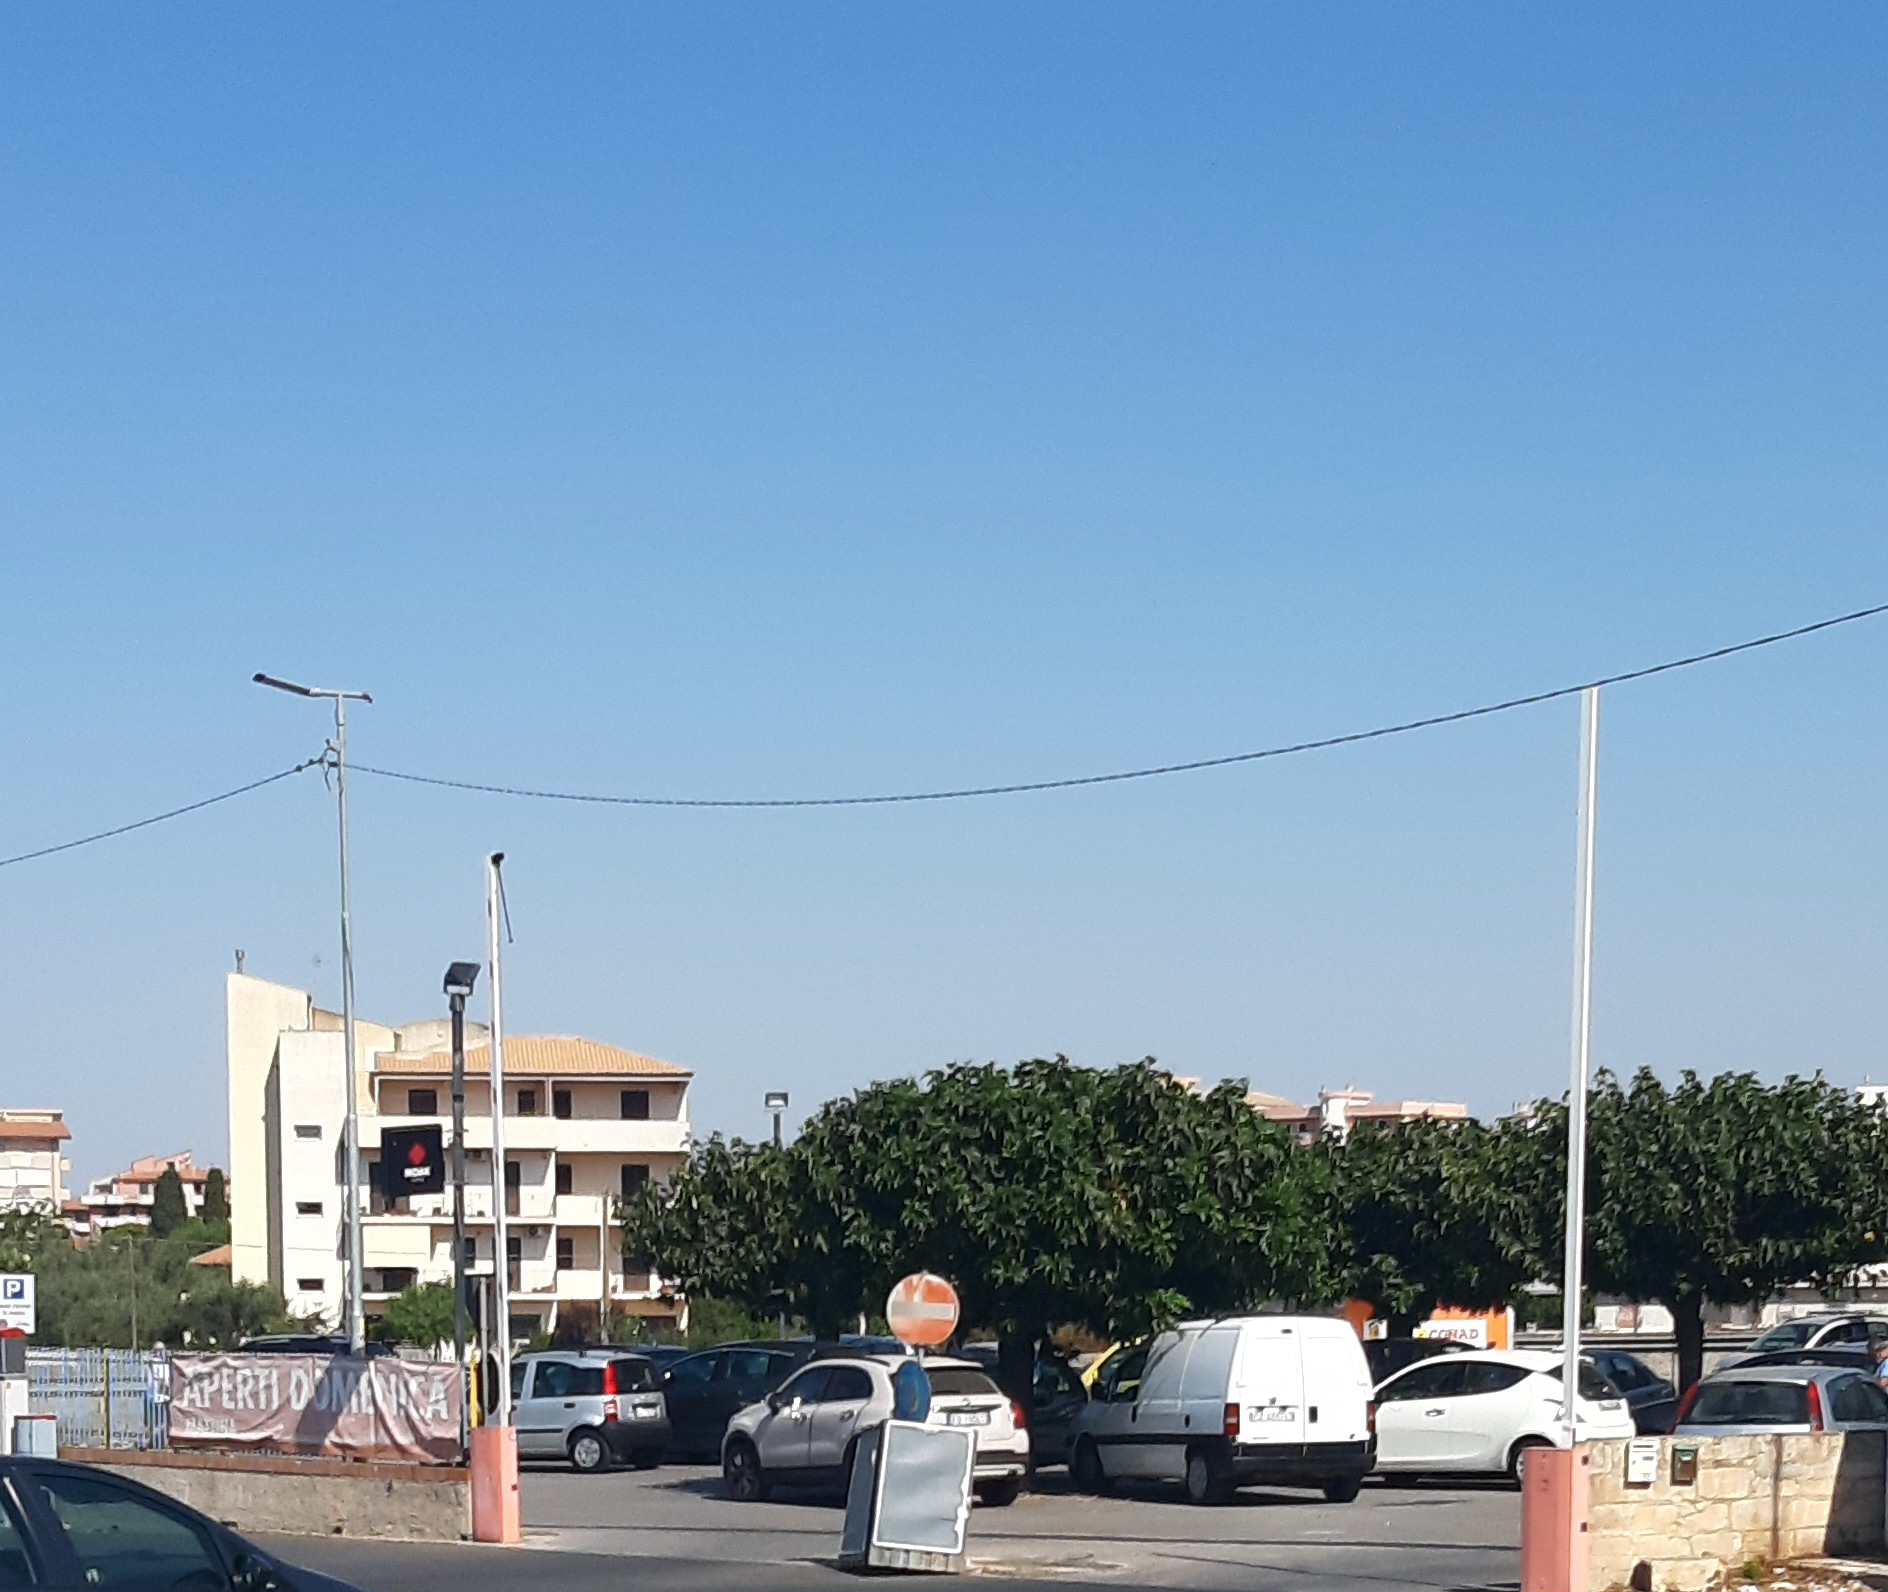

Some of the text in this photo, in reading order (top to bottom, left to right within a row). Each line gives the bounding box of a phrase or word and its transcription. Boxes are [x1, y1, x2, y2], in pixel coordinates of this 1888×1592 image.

[1428, 1328, 1479, 1340] CONAD
[182, 1366, 450, 1421] APERTI DOMENICA
